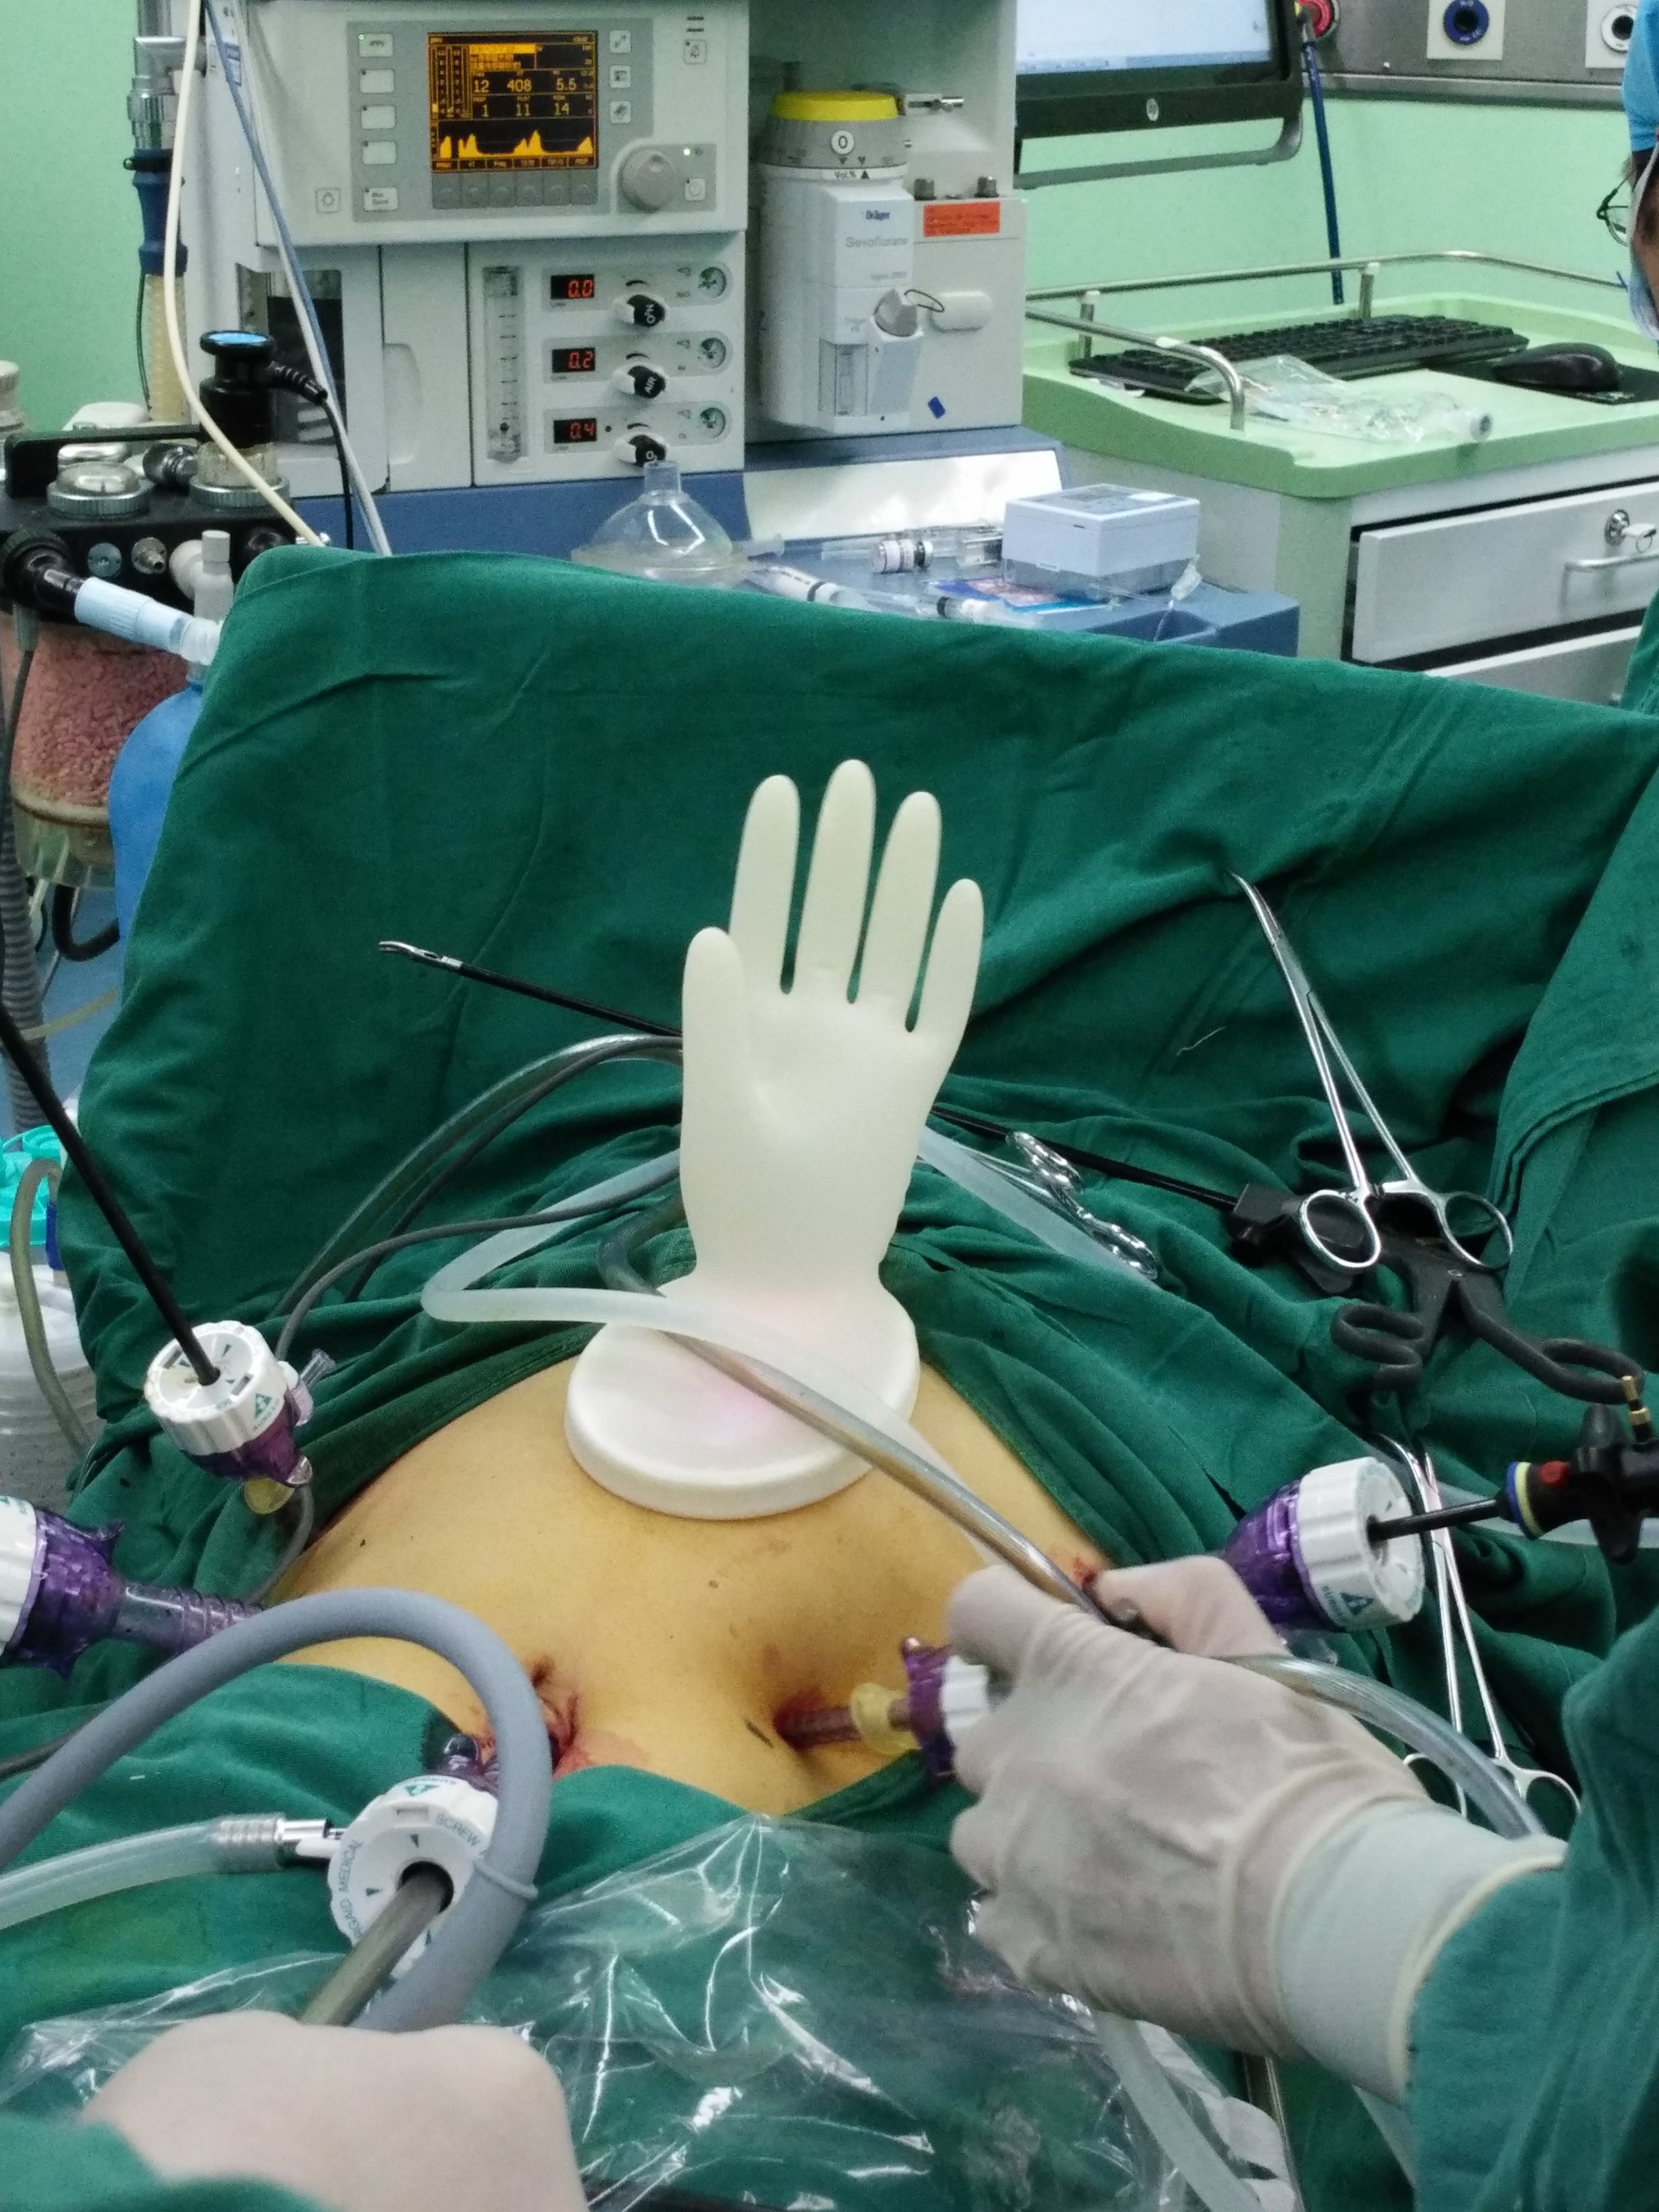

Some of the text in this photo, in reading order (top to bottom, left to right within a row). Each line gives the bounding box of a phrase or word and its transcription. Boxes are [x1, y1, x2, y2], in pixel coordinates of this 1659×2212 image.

[474, 80, 490, 93] 12
[506, 78, 532, 92] 408
[556, 77, 577, 91] 5.5
[482, 104, 489, 117] 1
[515, 103, 530, 117] 11
[554, 103, 570, 116] 14
[838, 135, 847, 148] 0
[568, 279, 593, 298] 0.0
[568, 350, 593, 369] 0.2
[645, 376, 656, 394] AIR
